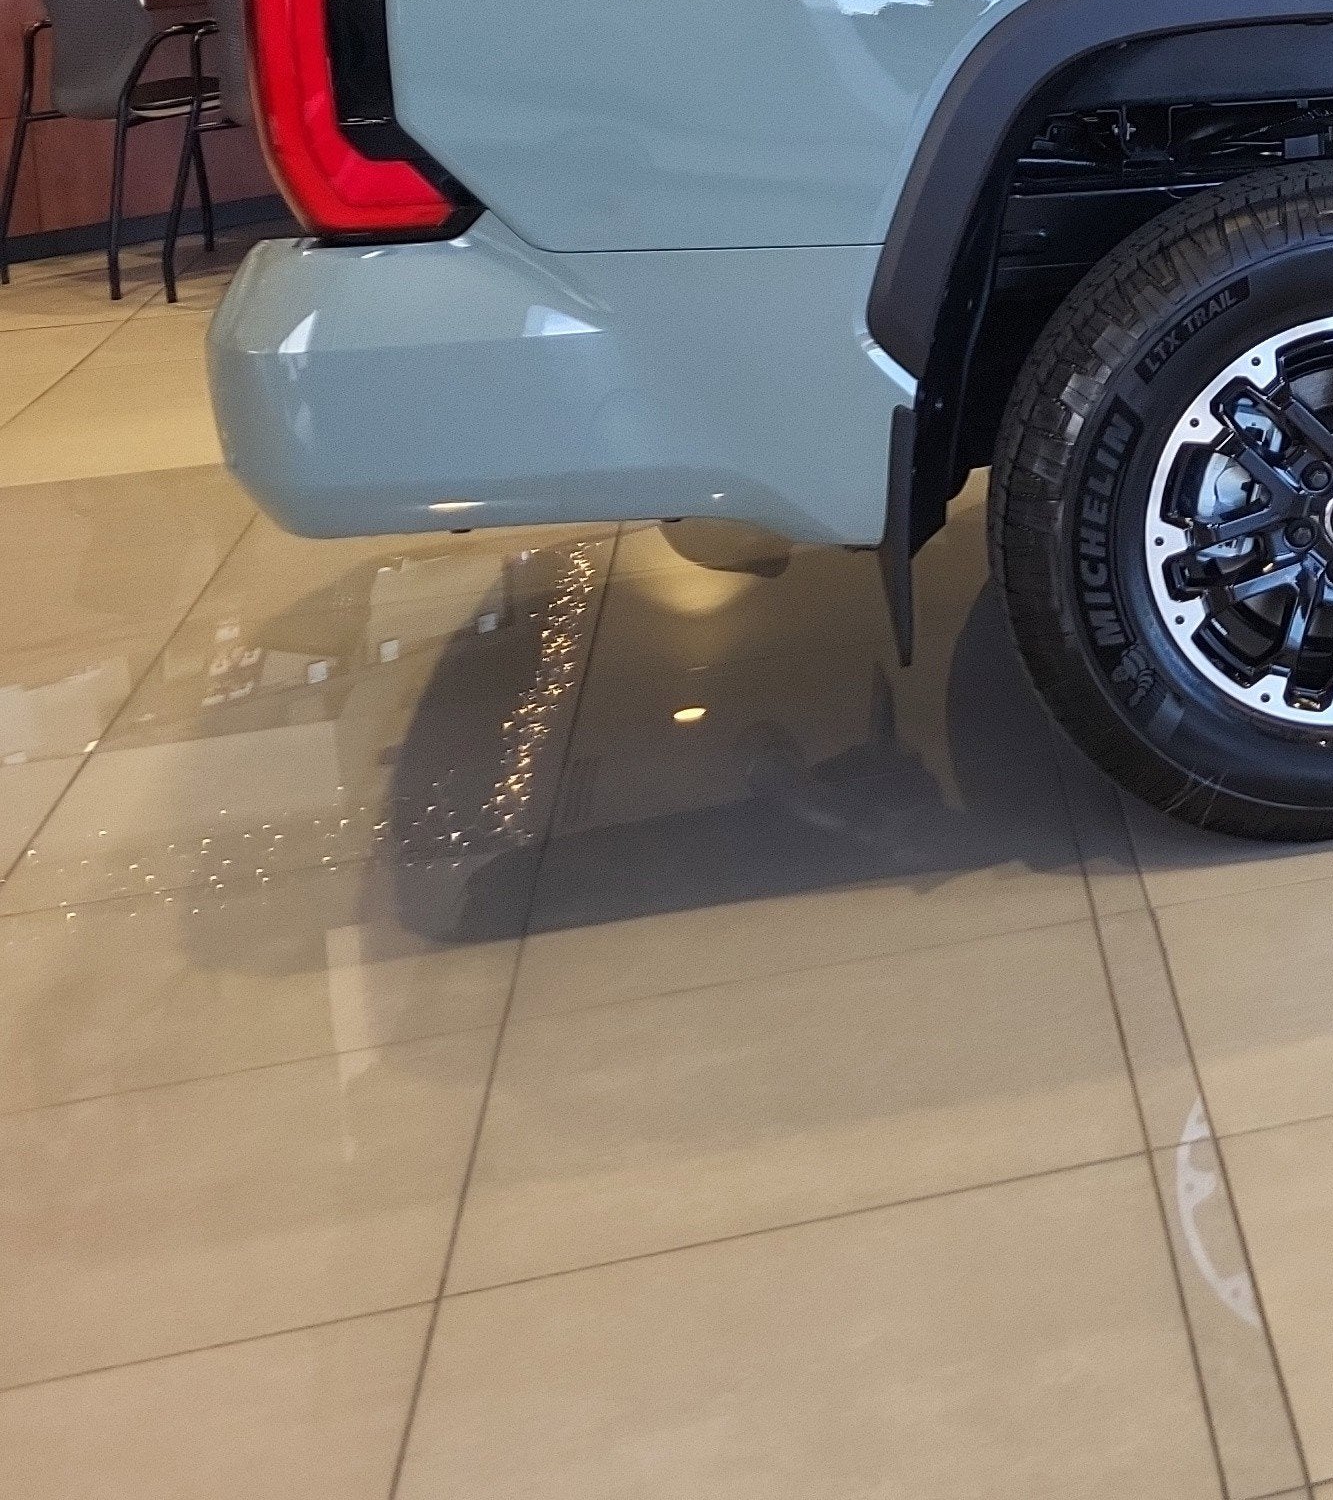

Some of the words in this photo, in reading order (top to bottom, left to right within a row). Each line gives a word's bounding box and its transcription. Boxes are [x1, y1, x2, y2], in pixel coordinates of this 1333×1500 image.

[1145, 329, 1180, 372] LTX
[1183, 289, 1237, 333] TRAIL
[1079, 412, 1135, 646] MICHELIN
